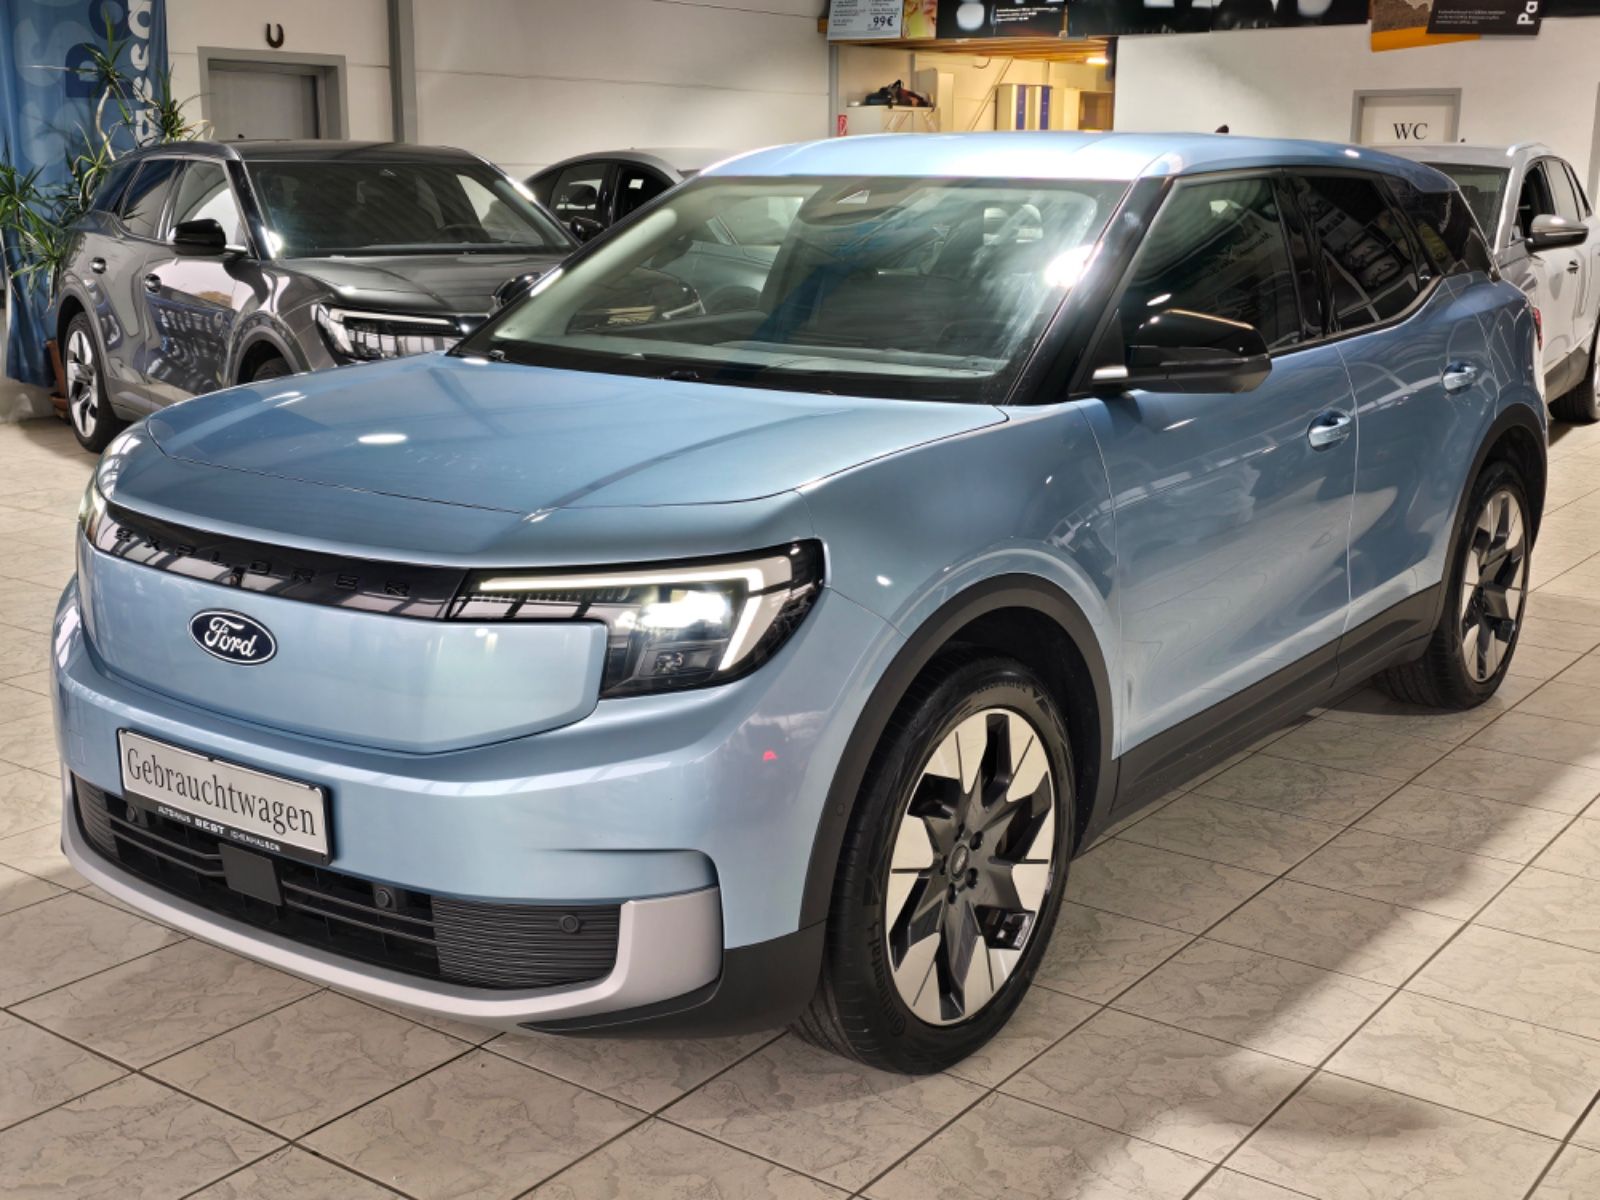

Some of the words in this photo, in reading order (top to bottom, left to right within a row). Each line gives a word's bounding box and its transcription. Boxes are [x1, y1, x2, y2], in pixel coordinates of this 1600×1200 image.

[1393, 122, 1429, 140] WC
[204, 616, 258, 657] Ford
[127, 747, 316, 836] Gebrauchtwagen
